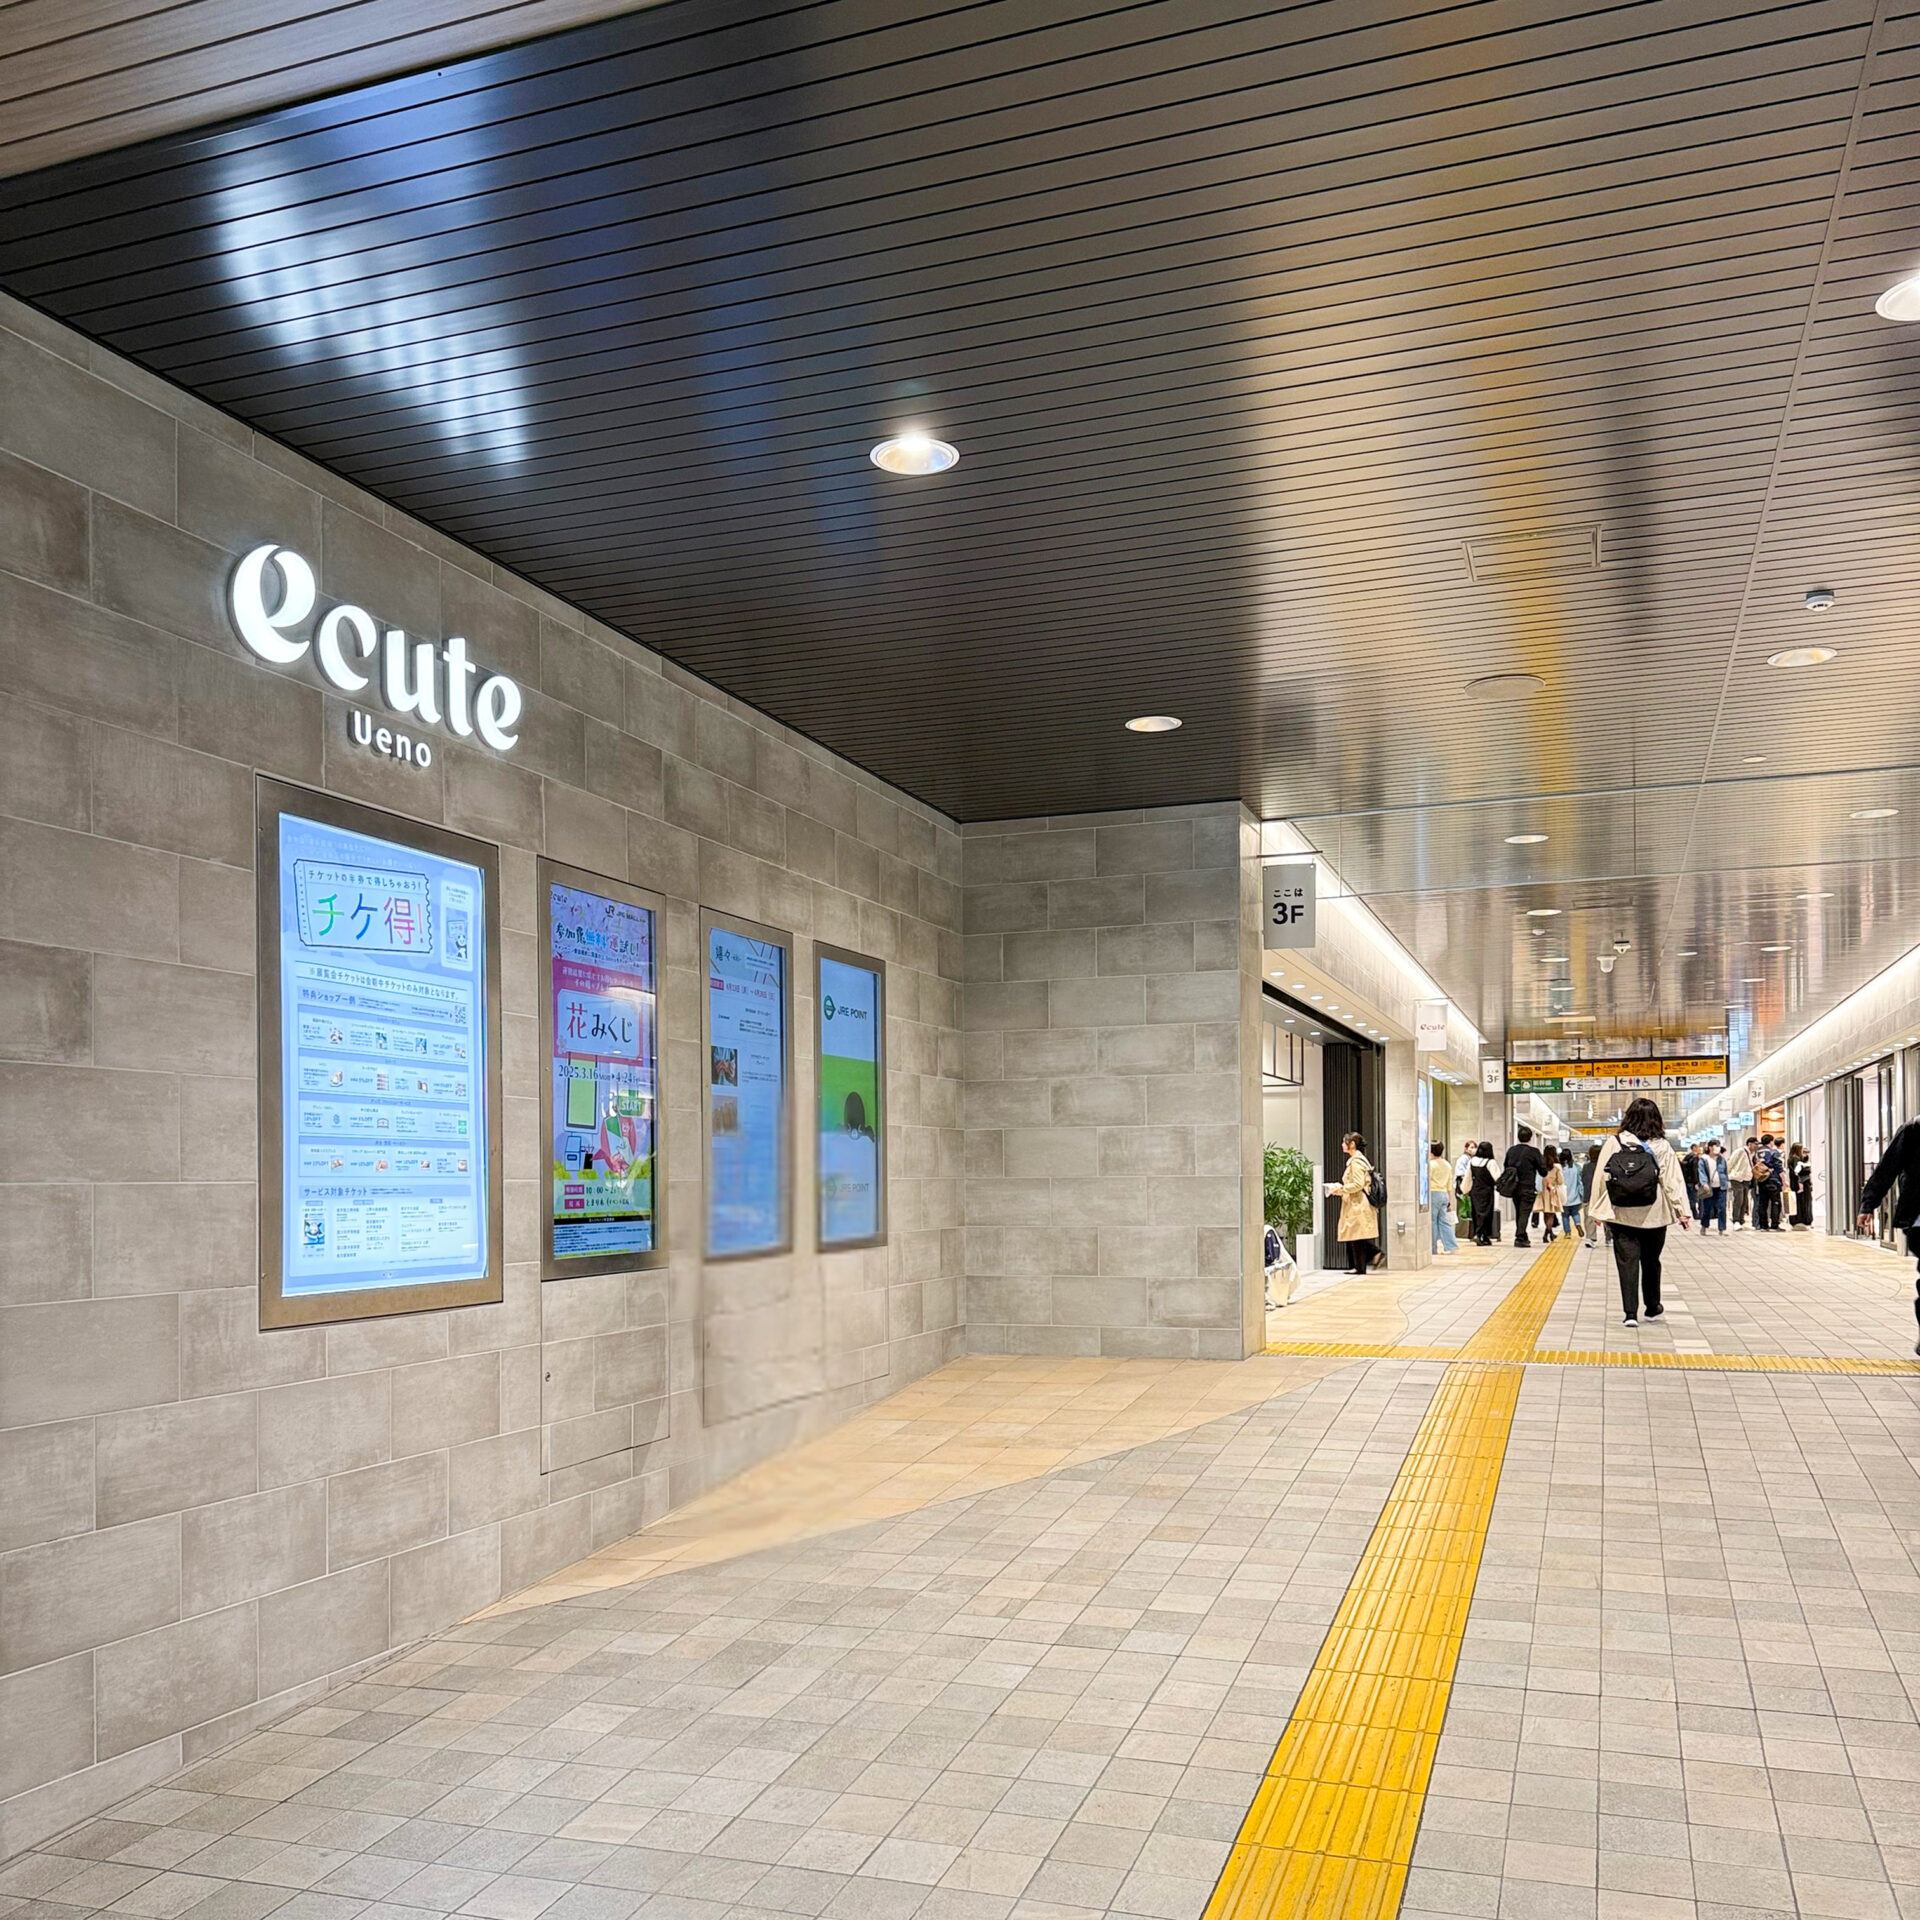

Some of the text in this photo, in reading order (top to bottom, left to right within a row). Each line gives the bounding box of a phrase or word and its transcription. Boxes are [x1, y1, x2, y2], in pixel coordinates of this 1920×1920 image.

[231, 543, 522, 751] ecute
[350, 710, 432, 768] Ueno
[1273, 888, 1303, 898] ここは
[1272, 902, 1304, 925] 3F
[566, 1001, 633, 1043] 花みくじ
[851, 1008, 867, 1020] POINT
[1487, 1074, 1500, 1083] 3F
